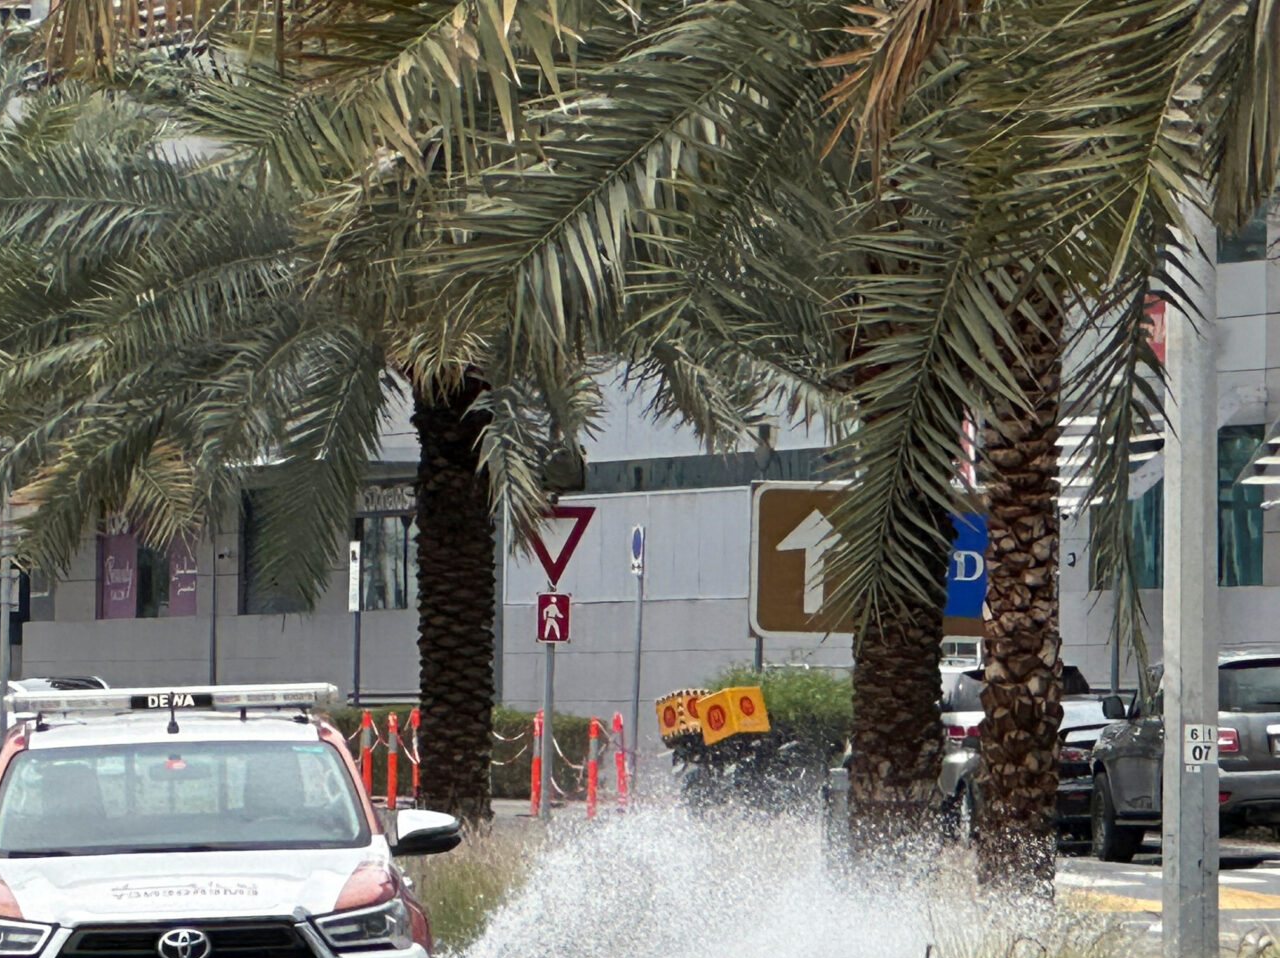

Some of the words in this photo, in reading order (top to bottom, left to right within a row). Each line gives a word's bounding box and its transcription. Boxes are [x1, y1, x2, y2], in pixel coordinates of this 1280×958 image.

[147, 694, 195, 708] DEWA
[1190, 728, 1199, 740] 6
[1192, 745, 1211, 761] 07
